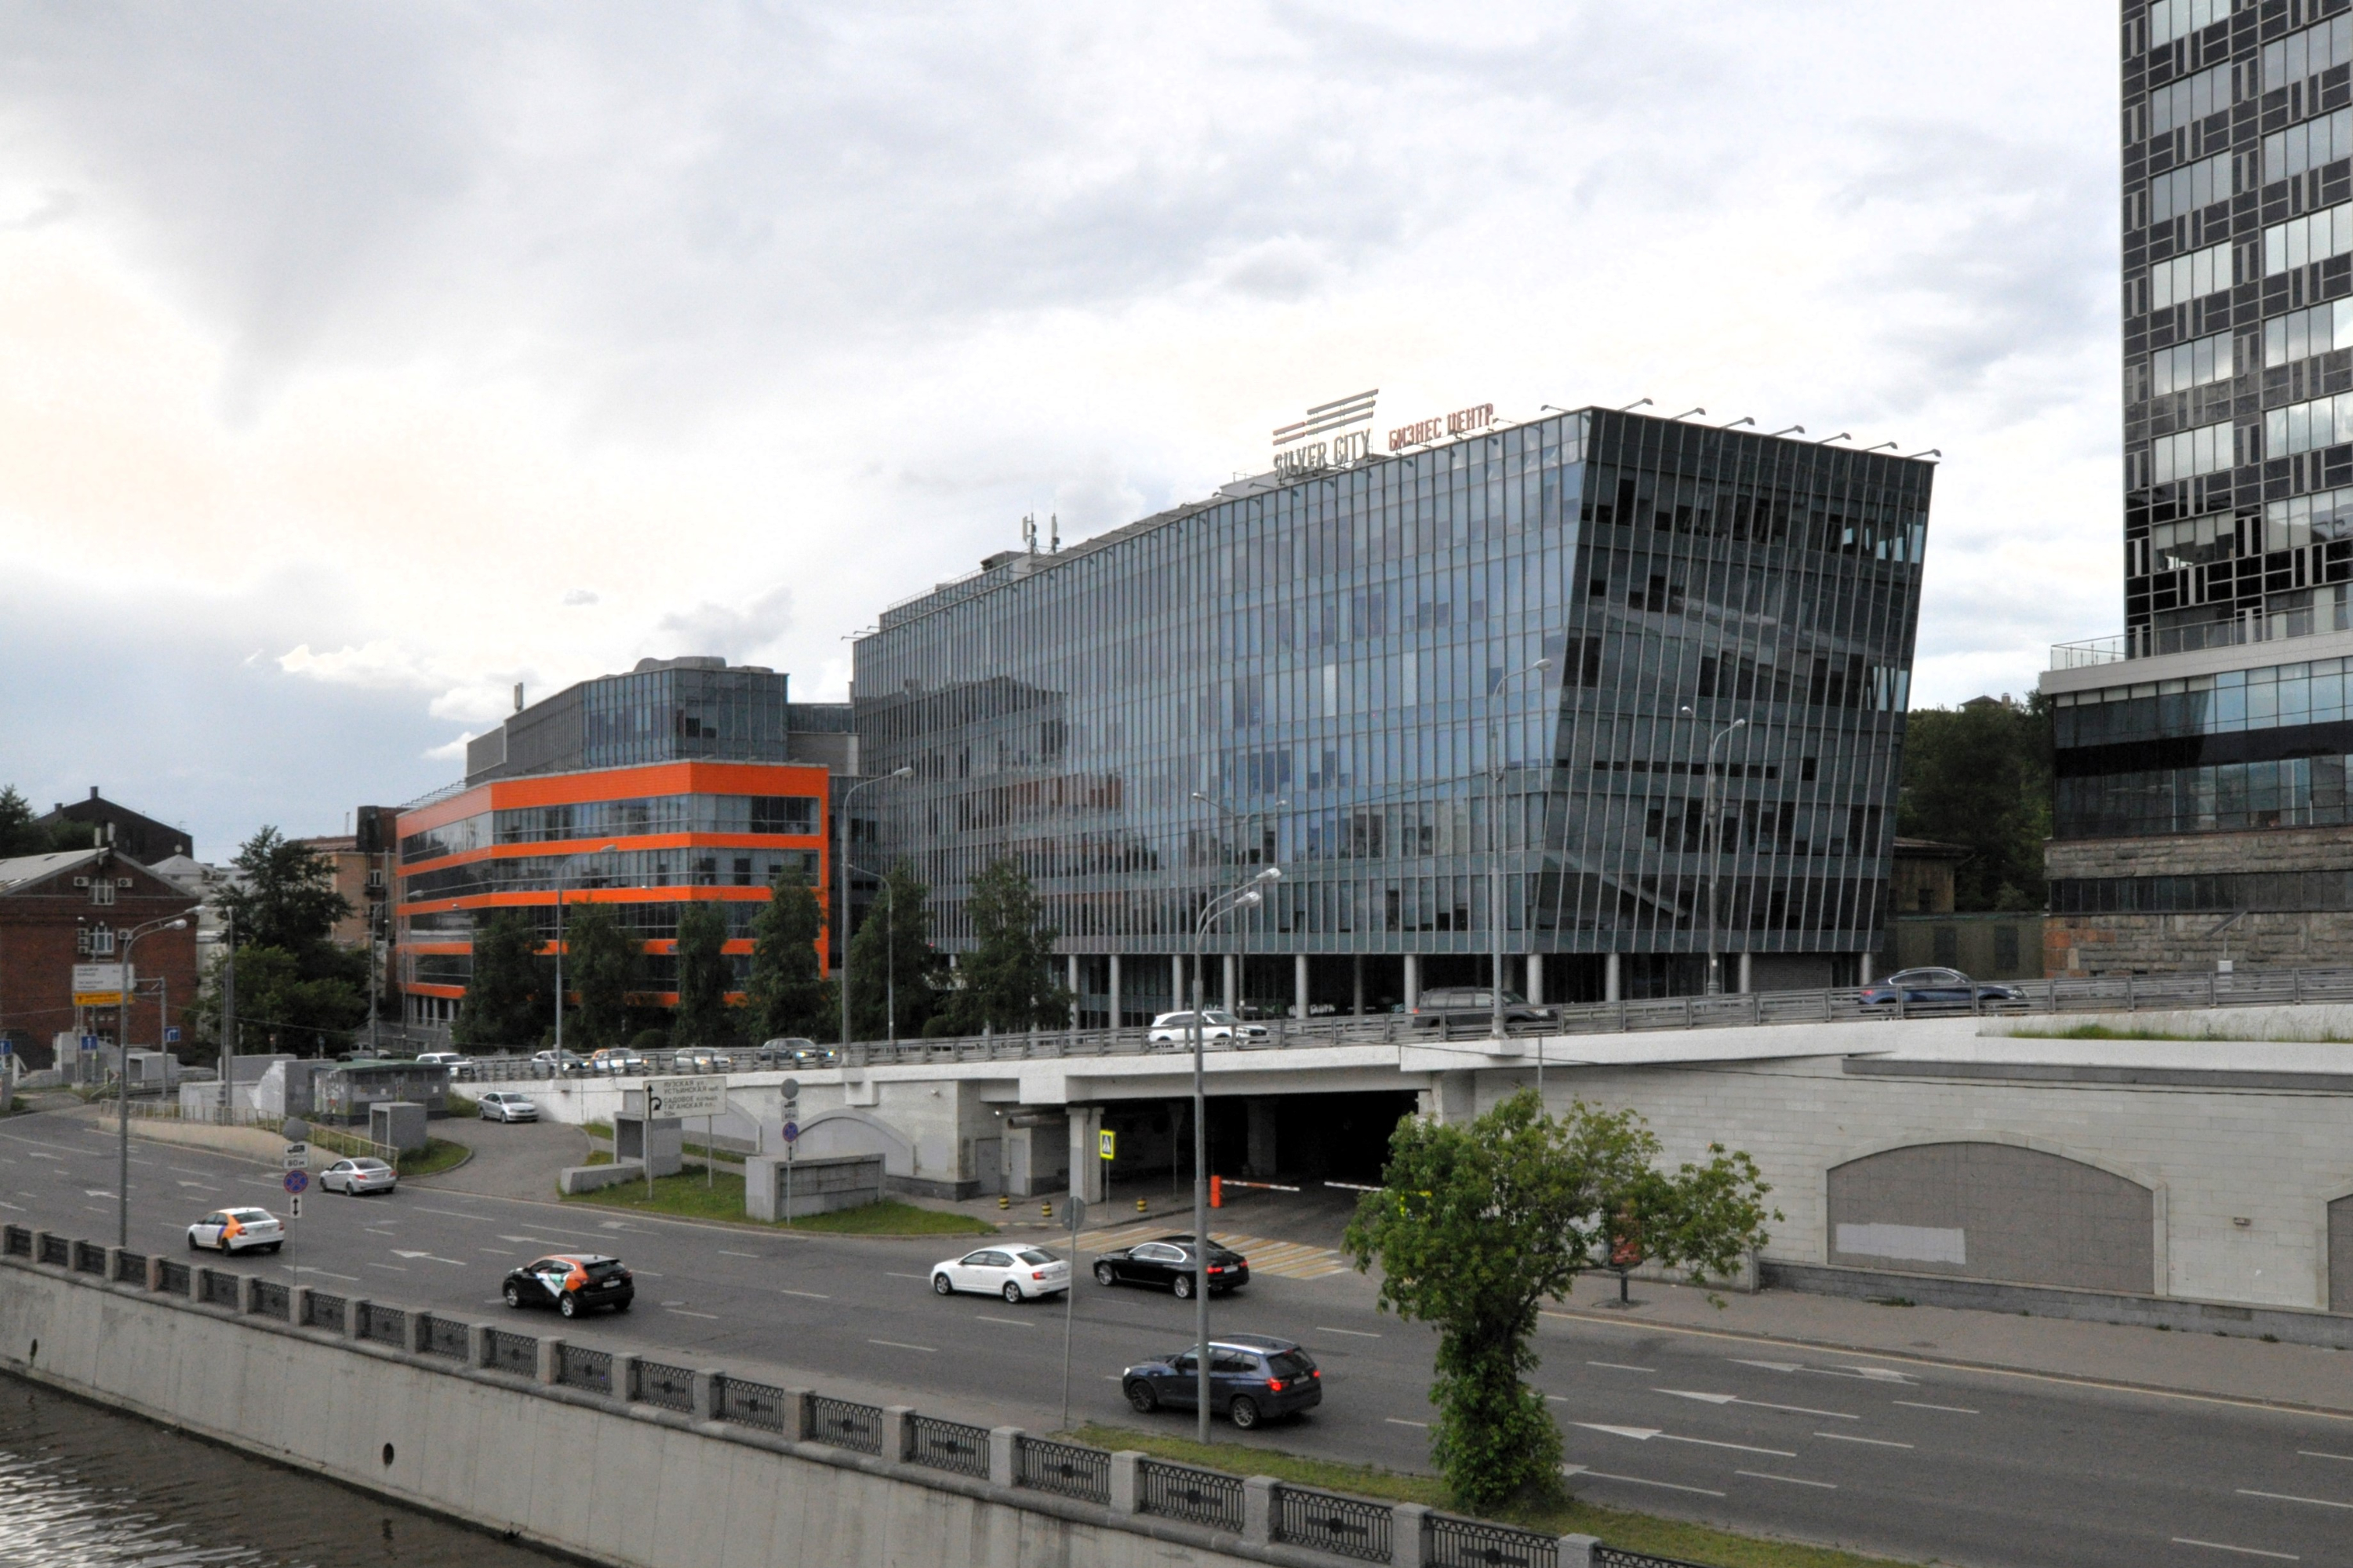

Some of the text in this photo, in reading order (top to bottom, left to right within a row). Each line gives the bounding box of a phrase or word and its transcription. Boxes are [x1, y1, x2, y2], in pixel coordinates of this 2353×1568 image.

[1388, 403, 1493, 451] БИЗНЕС ЦЕНТР
[1272, 427, 1371, 481] SILVER CITY
[664, 1086, 707, 1094] УСТЬИНСКАЯ
[664, 1101, 703, 1110] ТАГАНСКАЯ
